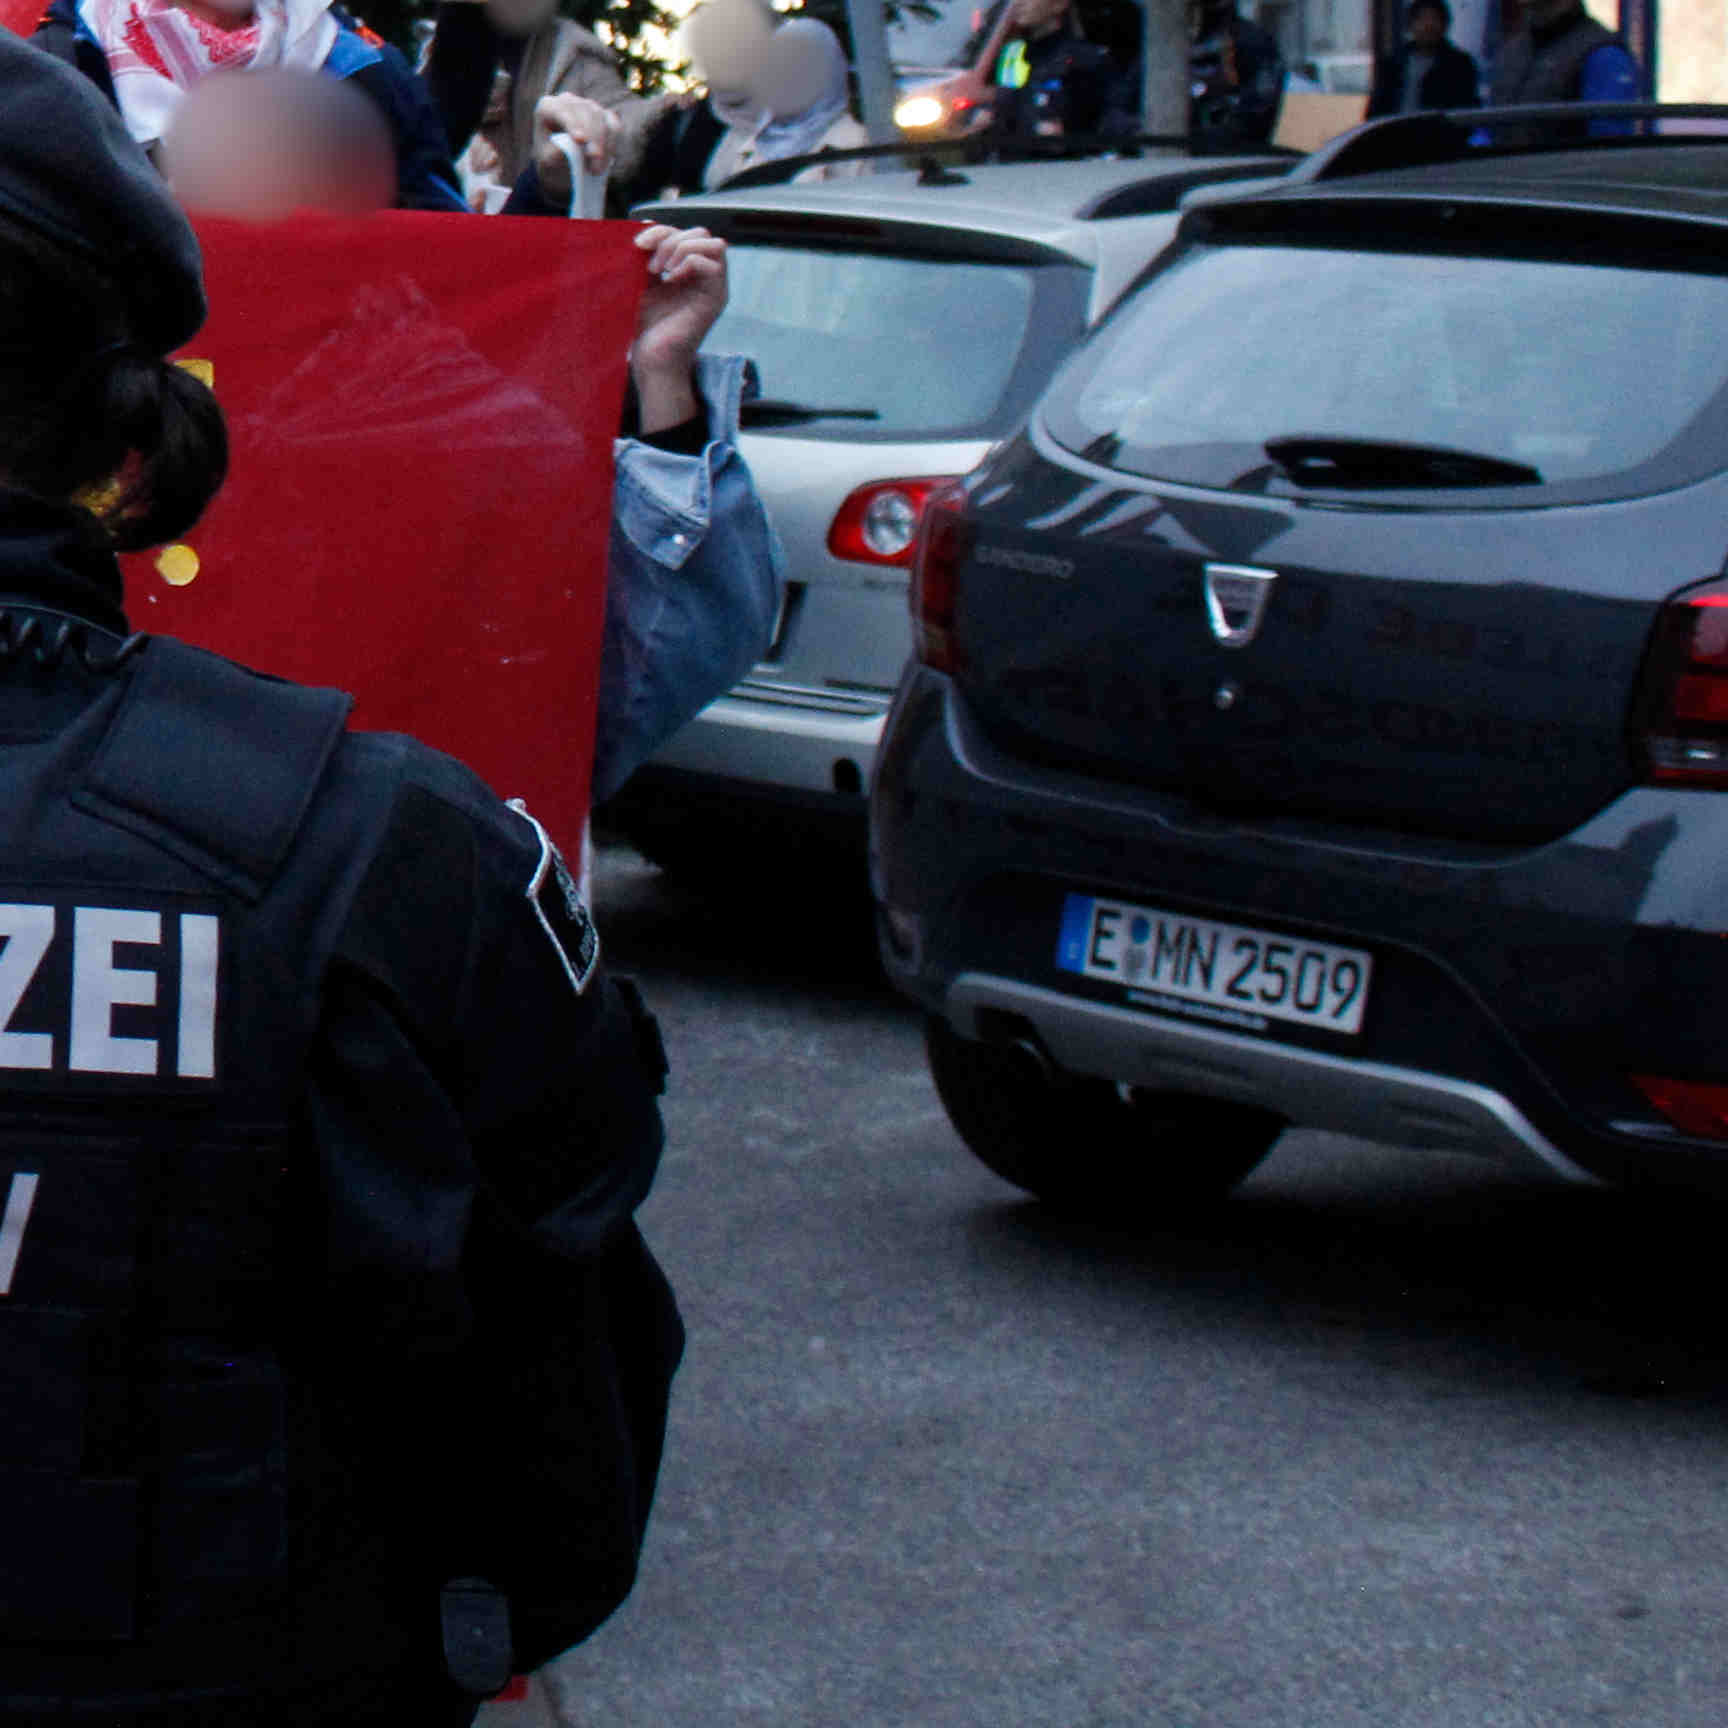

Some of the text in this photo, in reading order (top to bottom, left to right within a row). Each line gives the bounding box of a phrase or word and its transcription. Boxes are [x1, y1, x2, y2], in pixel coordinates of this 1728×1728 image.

[1090, 908, 1122, 971] E
[1152, 921, 1220, 992] MN
[1226, 938, 1363, 1019] 2509
